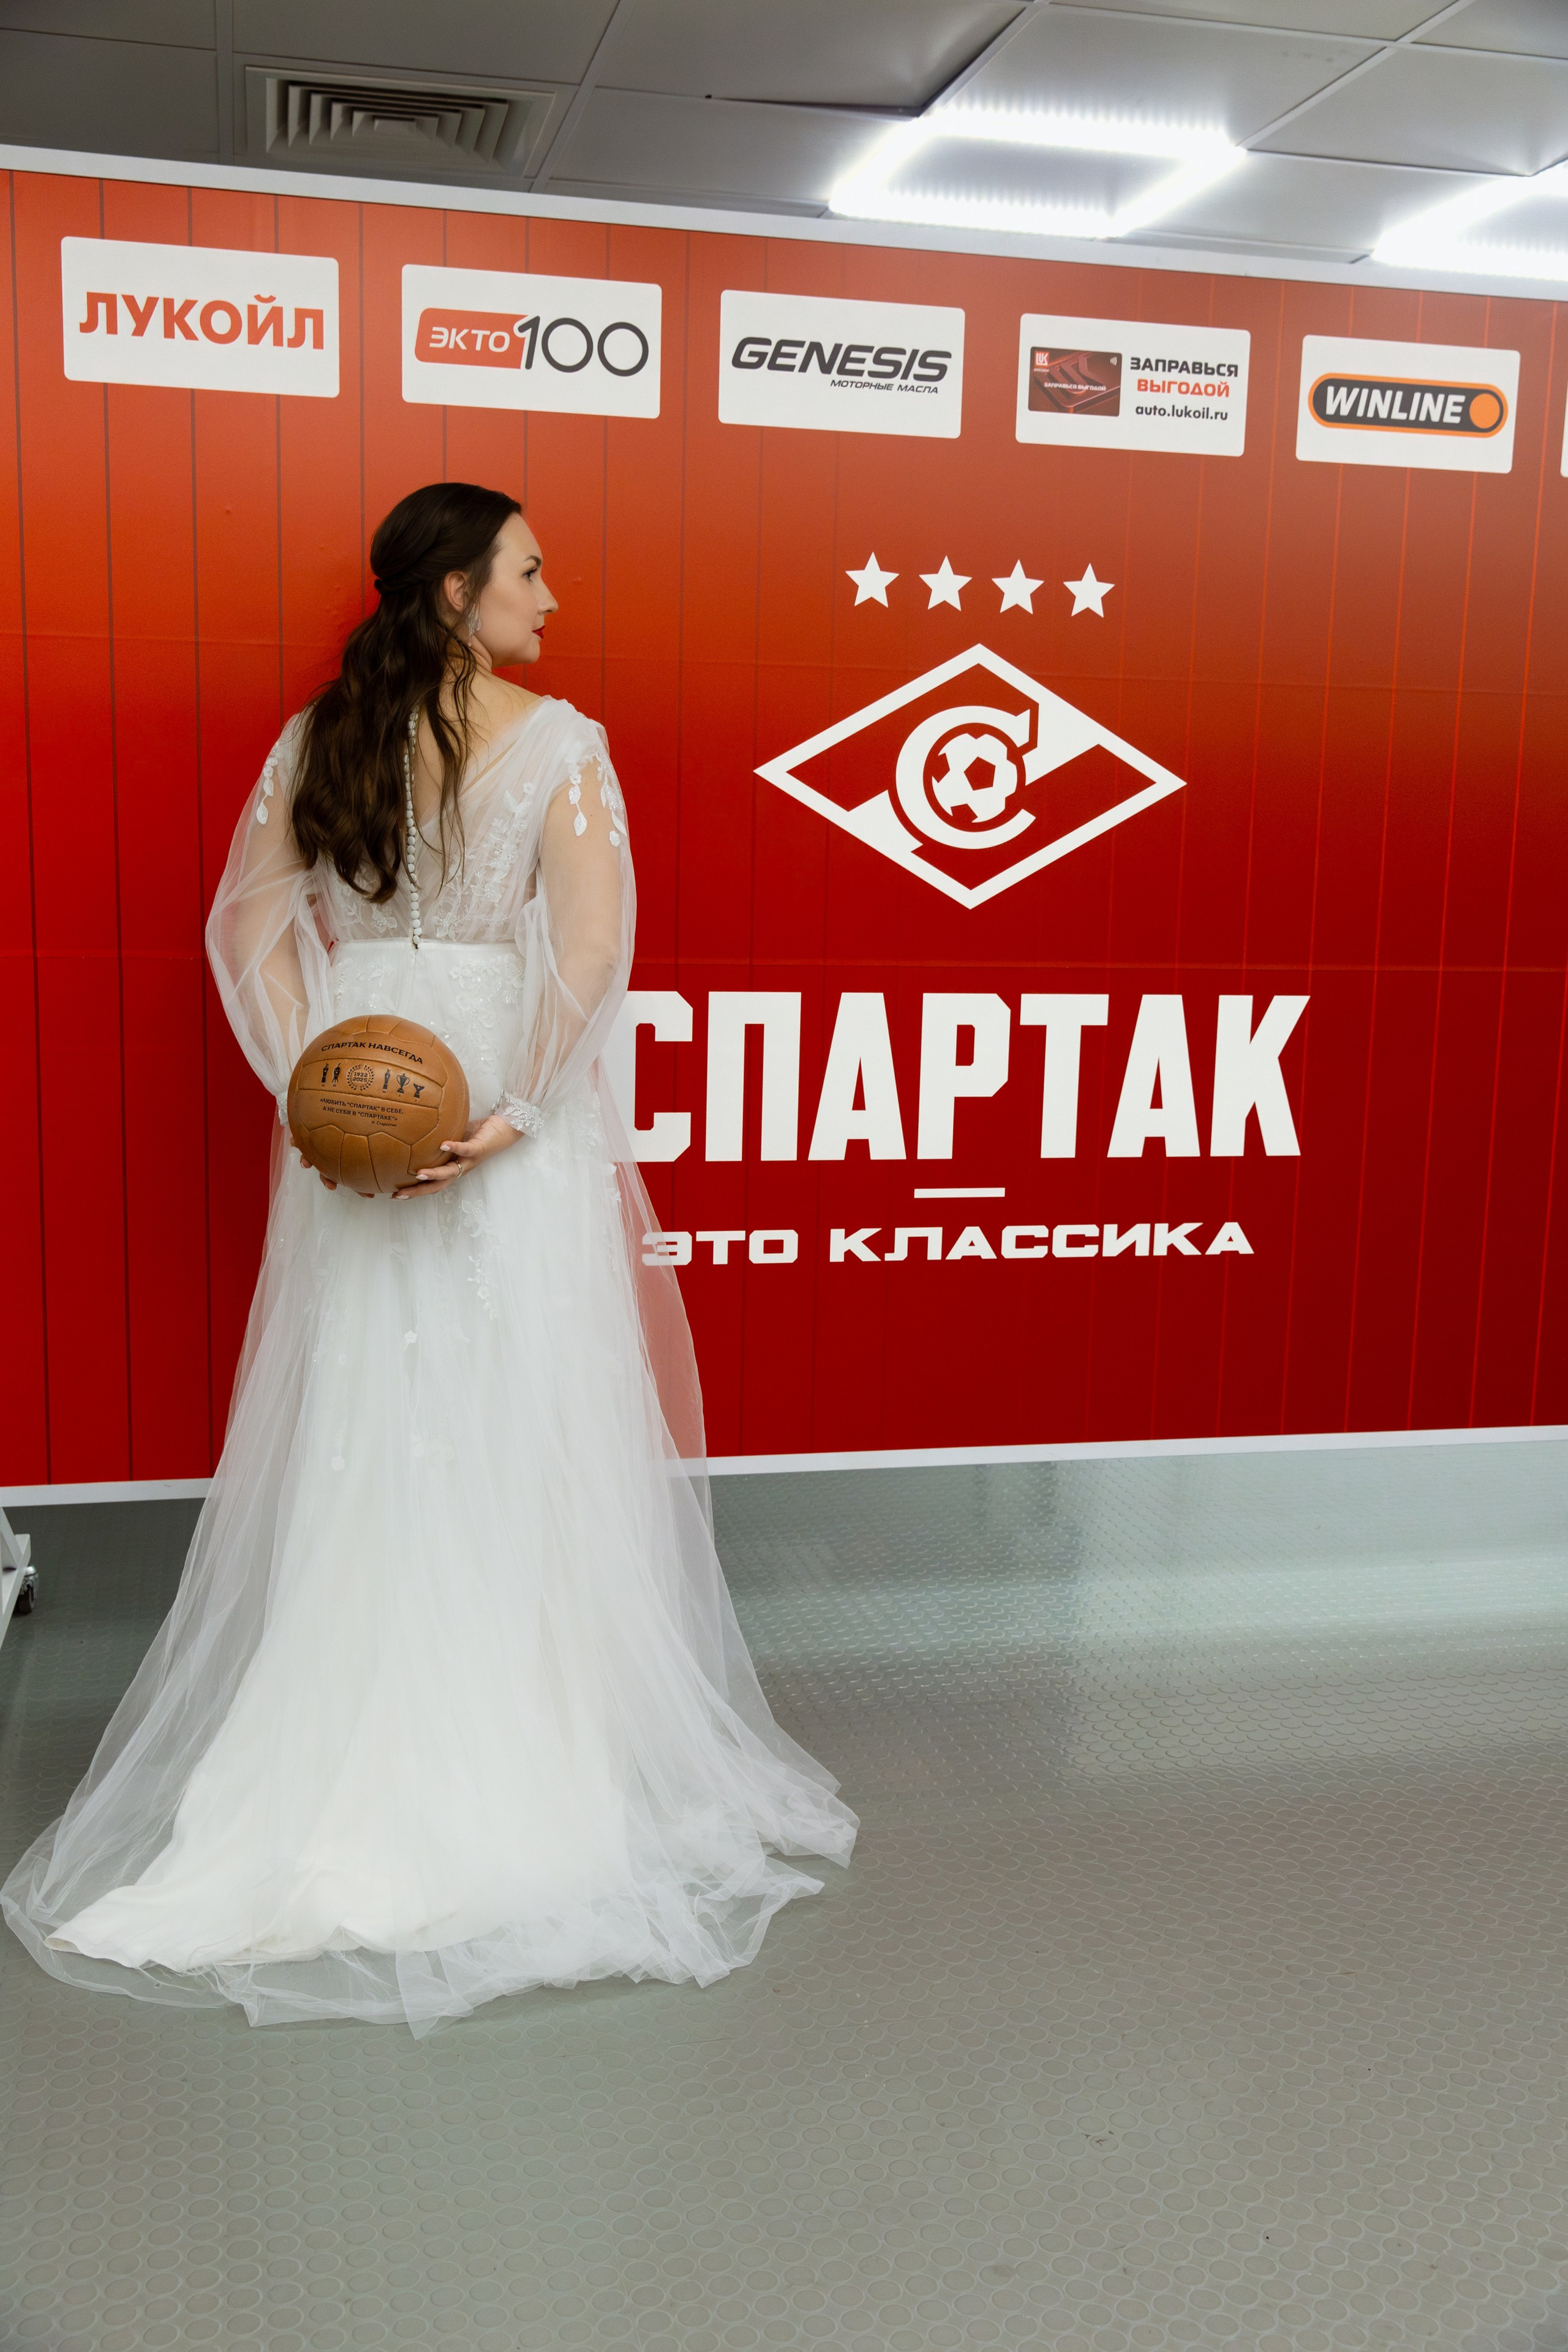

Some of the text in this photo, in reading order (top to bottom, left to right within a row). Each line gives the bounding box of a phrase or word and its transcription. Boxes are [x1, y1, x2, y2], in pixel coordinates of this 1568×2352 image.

[79, 292, 323, 350] ЛУКОЙЛ
[731, 336, 952, 382] GENESIS
[1130, 356, 1238, 377] ЗАПРАВЬСЯ
[830, 379, 939, 394] МОТОРНЫЕ МАСЛА
[1137, 379, 1229, 398] ВЫГОДОЙ
[1135, 404, 1228, 421] auto.lukoil.ru
[1325, 385, 1466, 424] WINLINE
[321, 1042, 423, 1065] СПАРТАК НАВСЕГДА
[599, 990, 1311, 1162] СПАРТАК
[642, 1222, 1254, 1266] ЭТО КЛАССИКА
